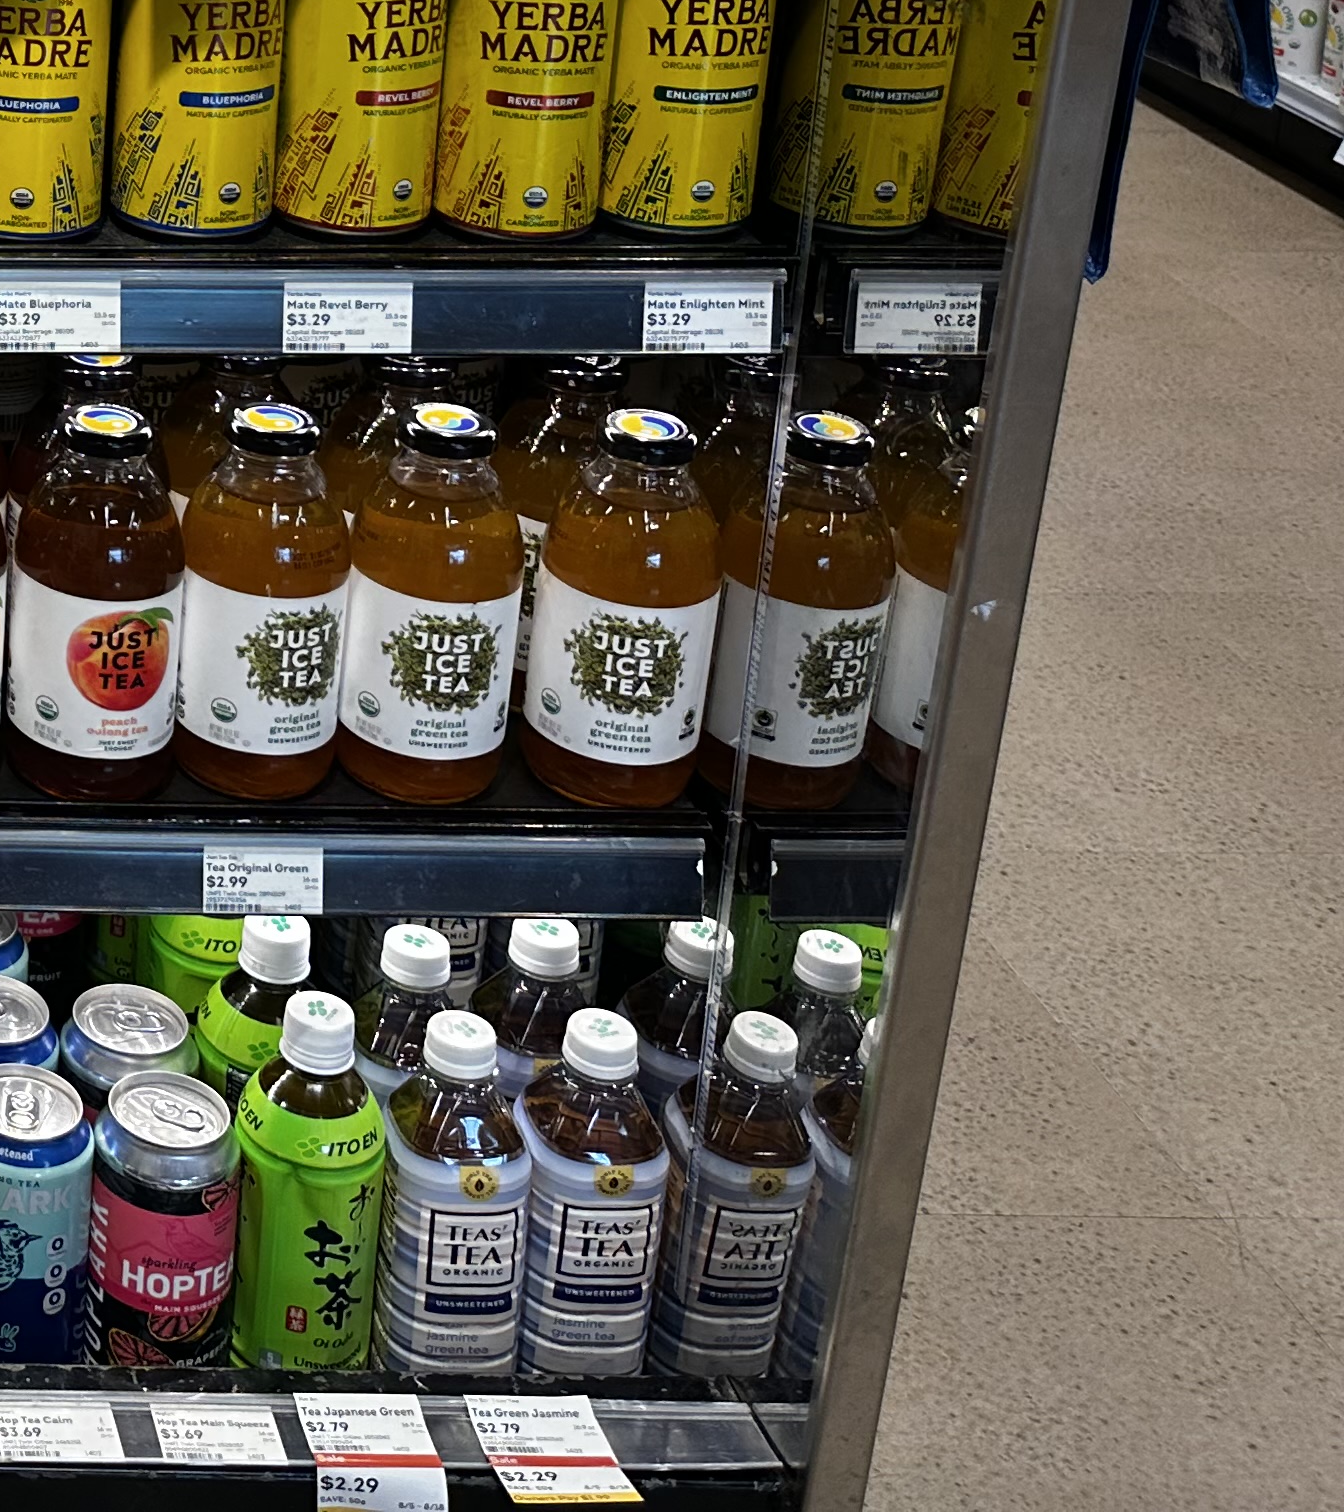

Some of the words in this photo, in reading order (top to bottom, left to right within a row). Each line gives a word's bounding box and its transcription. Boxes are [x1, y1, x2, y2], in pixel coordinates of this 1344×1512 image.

[665, 88, 729, 102] ENLIGHTEN
[731, 86, 753, 100] MINT
[648, 300, 676, 310] Mate
[679, 298, 732, 312] Enlighten
[735, 298, 765, 310] Mint
[648, 312, 691, 328] $3.29
[594, 632, 668, 656] JUST
[606, 656, 654, 676] ICE
[602, 676, 653, 697] TEA
[326, 1136, 362, 1159] ITO
[361, 1126, 380, 1150] EN
[446, 1224, 508, 1242] TEAS'
[445, 1245, 502, 1265] TEA
[304, 1220, 361, 1330] お茶
[442, 1268, 503, 1277] ORGANIC
